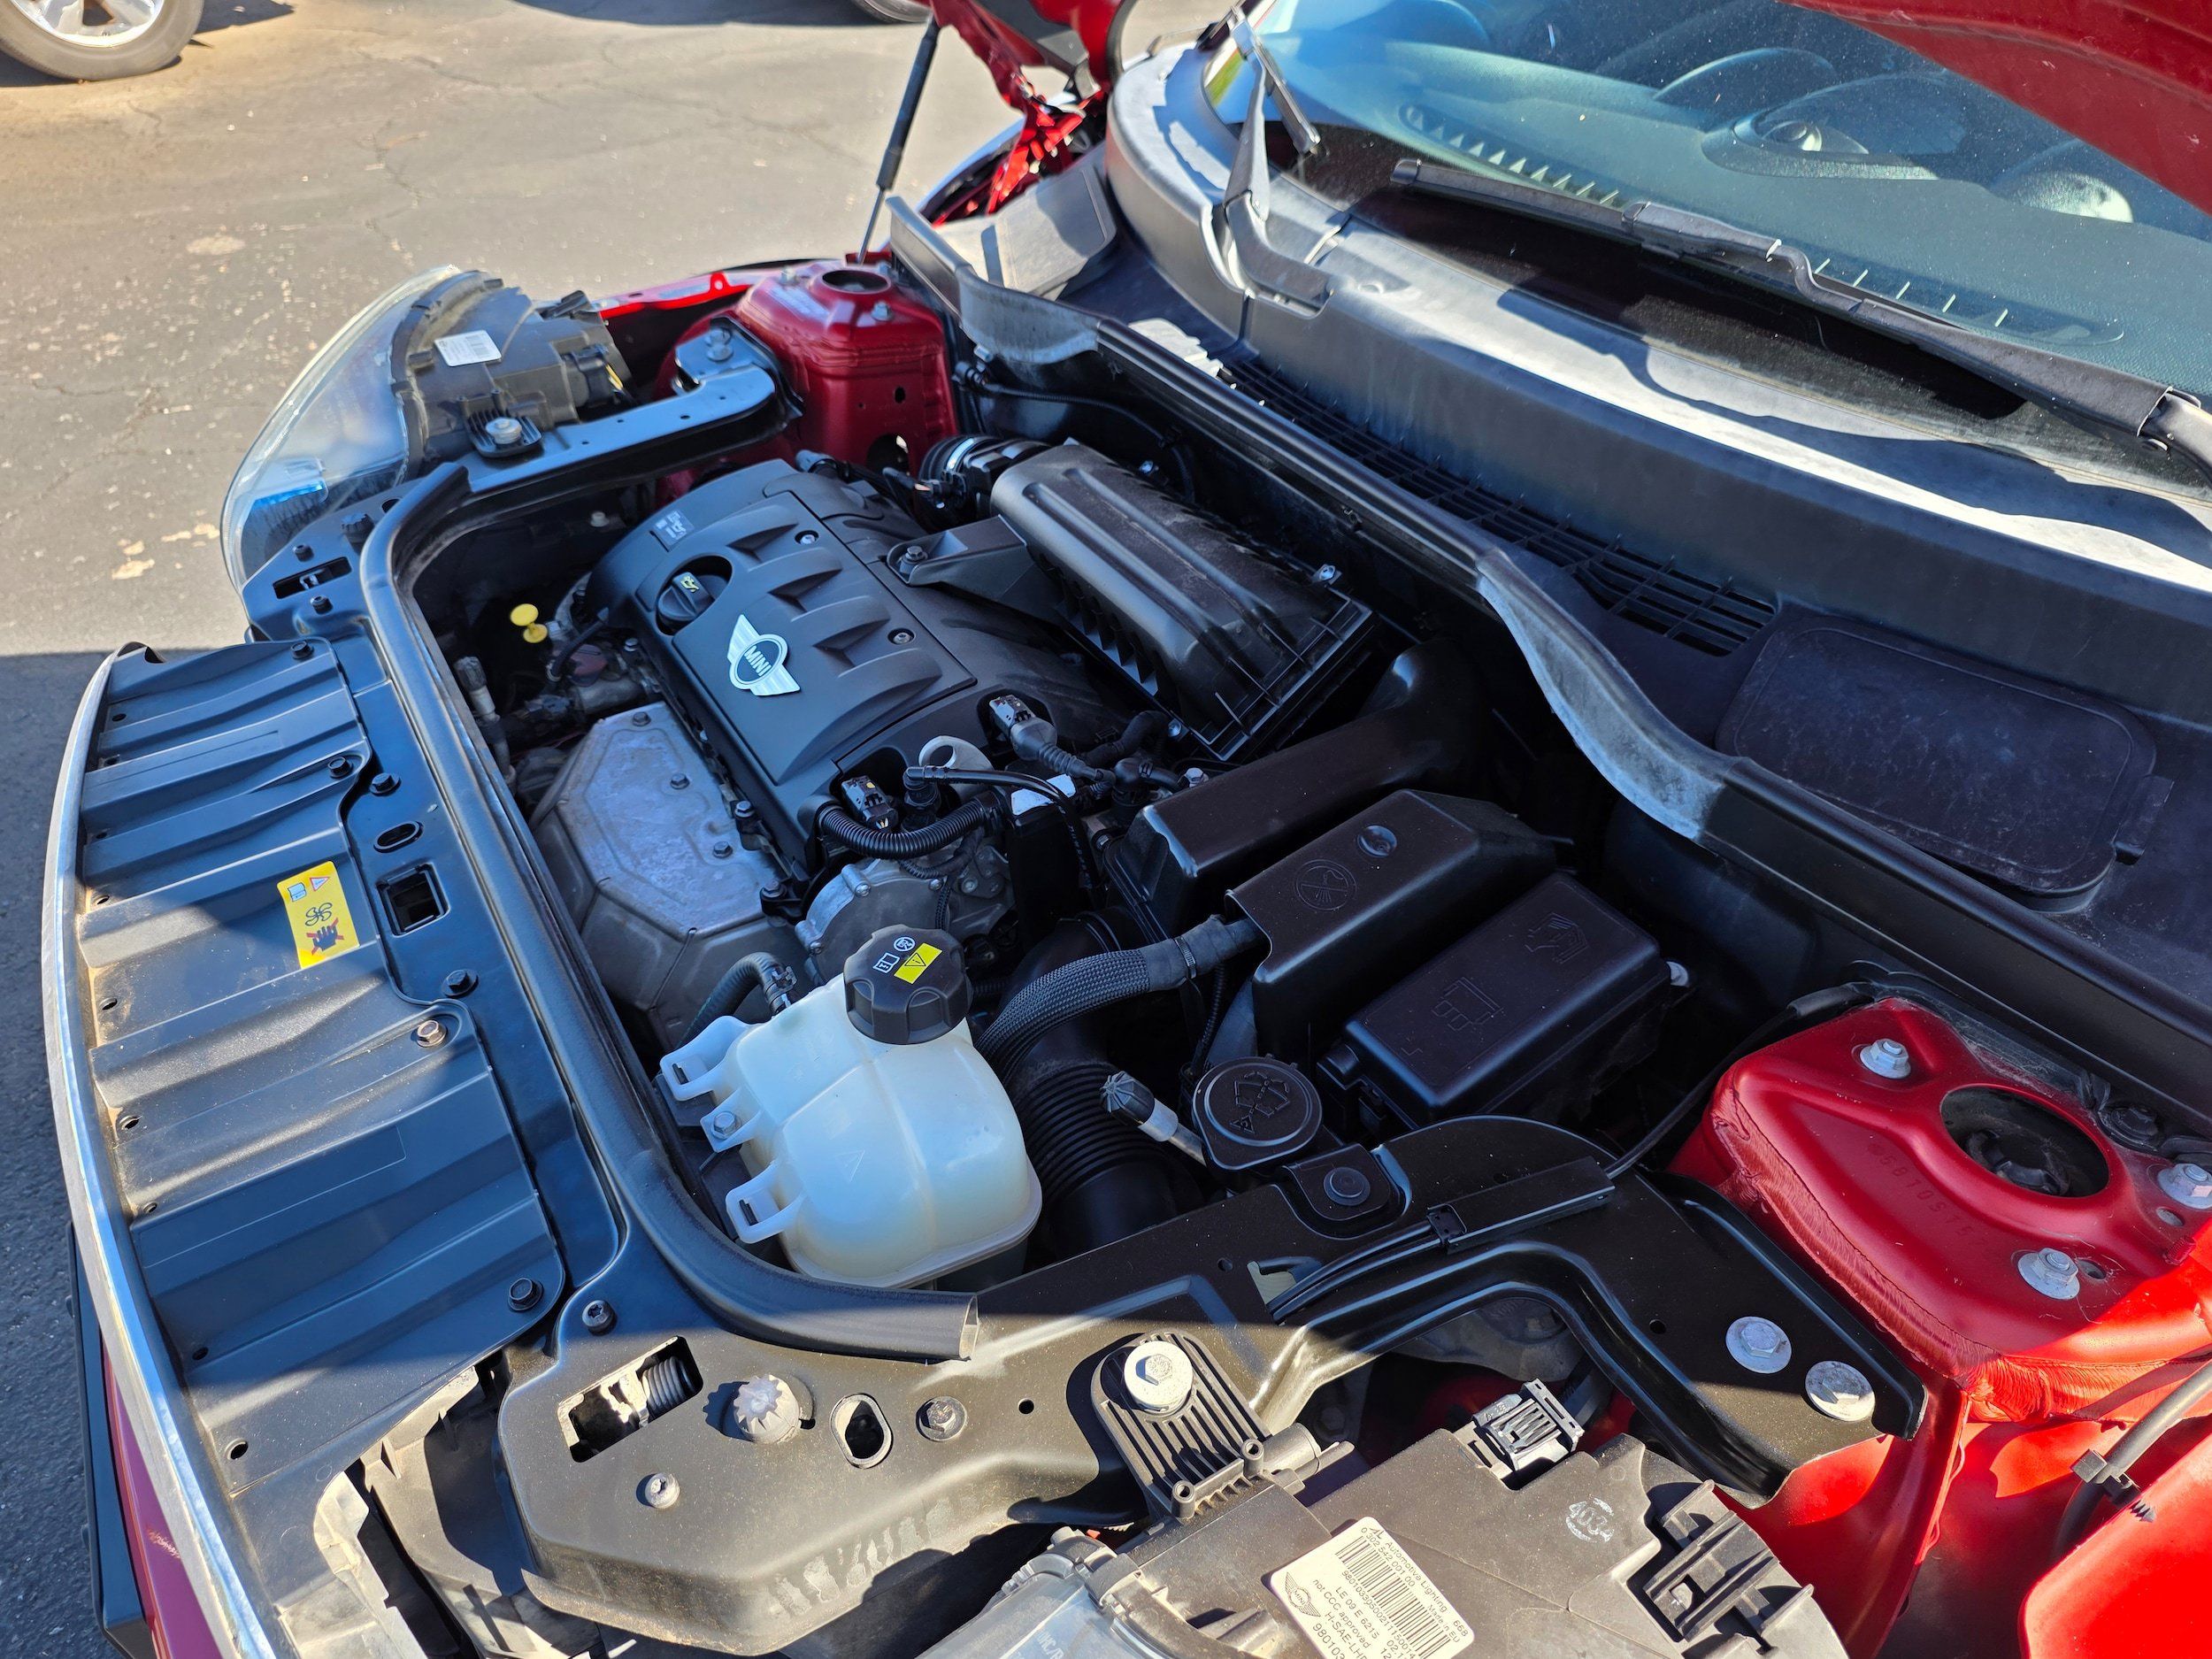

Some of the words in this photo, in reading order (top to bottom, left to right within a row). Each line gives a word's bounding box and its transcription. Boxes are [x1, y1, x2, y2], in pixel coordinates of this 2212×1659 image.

[744, 645, 772, 677] MINI
[1366, 1532, 1380, 1547] 302
[1379, 1546, 1394, 1561] 542
[1392, 1561, 1407, 1575] 001
[1404, 1576, 1416, 1587] 00
[1294, 1589, 1306, 1606] MINI
[1386, 1541, 1423, 1581] Automotive
[1421, 1580, 1448, 1613] Lighting
[1453, 1619, 1469, 1637] 668
[1313, 1578, 1325, 1593] not
[1324, 1591, 1341, 1611] CCC
[1339, 1611, 1371, 1648] approved
[1335, 1586, 1348, 1599] LE
[1345, 1599, 1356, 1610] 09
[1354, 1609, 1363, 1618] E
[1361, 1617, 1380, 1640] 6215
[1428, 1604, 1444, 1624] Made
[1448, 1631, 1461, 1643] EU
[1386, 1640, 1404, 1659] 02.1
